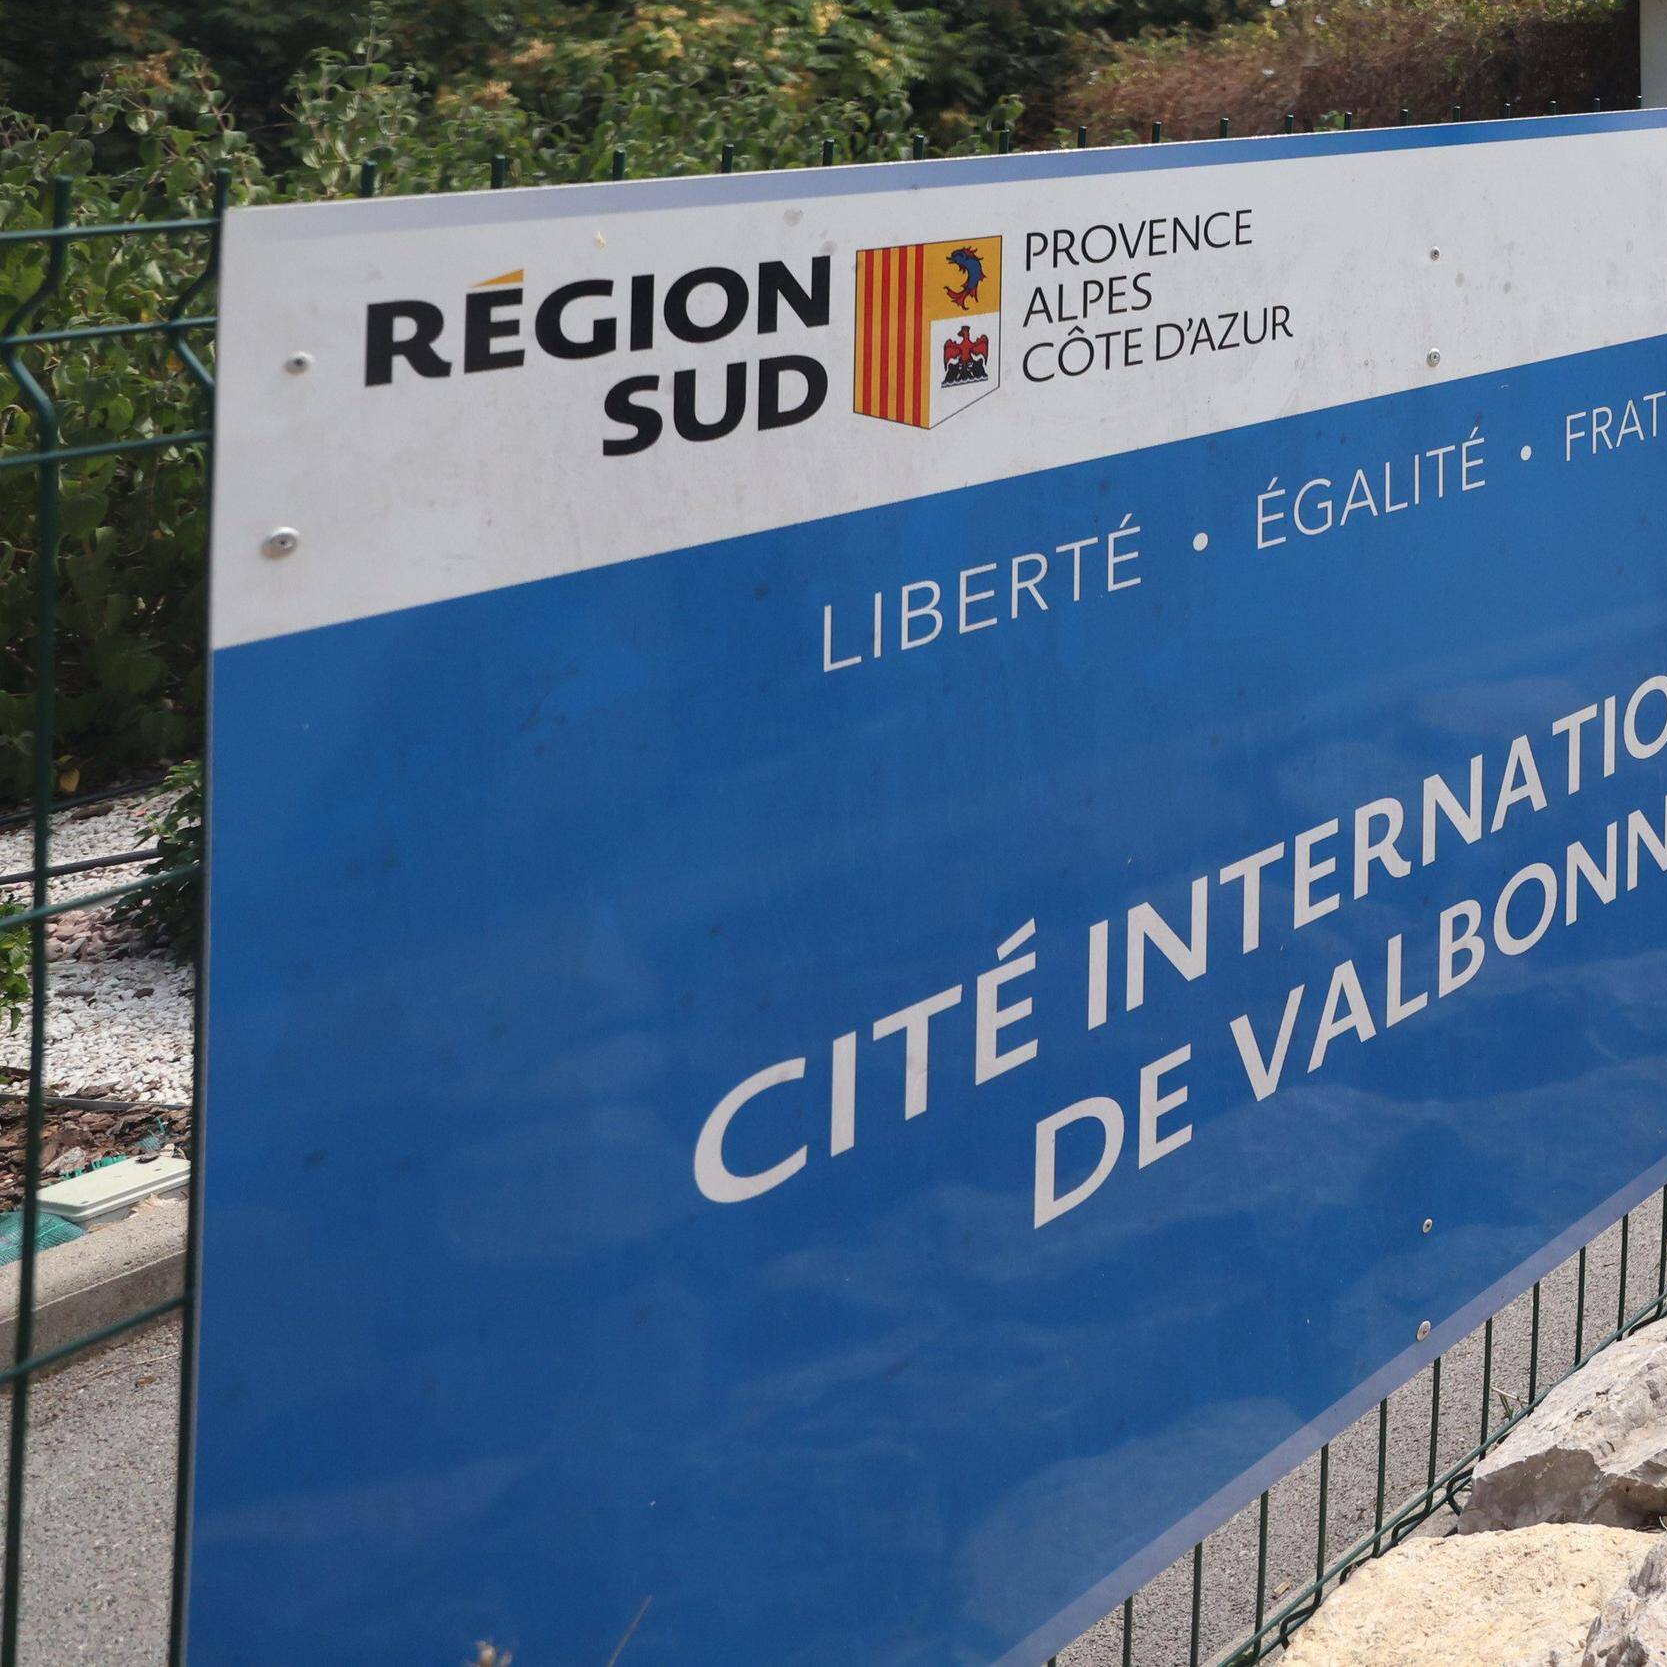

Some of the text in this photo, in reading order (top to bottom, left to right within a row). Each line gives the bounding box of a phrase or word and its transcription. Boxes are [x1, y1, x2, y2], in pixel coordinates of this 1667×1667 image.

[1025, 209, 1253, 272] PROVENCE
[364, 254, 831, 387] RÉGION
[1022, 272, 1152, 328] ALPES
[1022, 305, 1294, 383] CÔTE D'AZUR
[602, 354, 829, 457] SUD
[823, 512, 1142, 673] LIBERTÉ
[1257, 425, 1486, 550] ÉGALITÉ
[694, 917, 1039, 1203] CITÉ
[1033, 1043, 1193, 1230] DE
